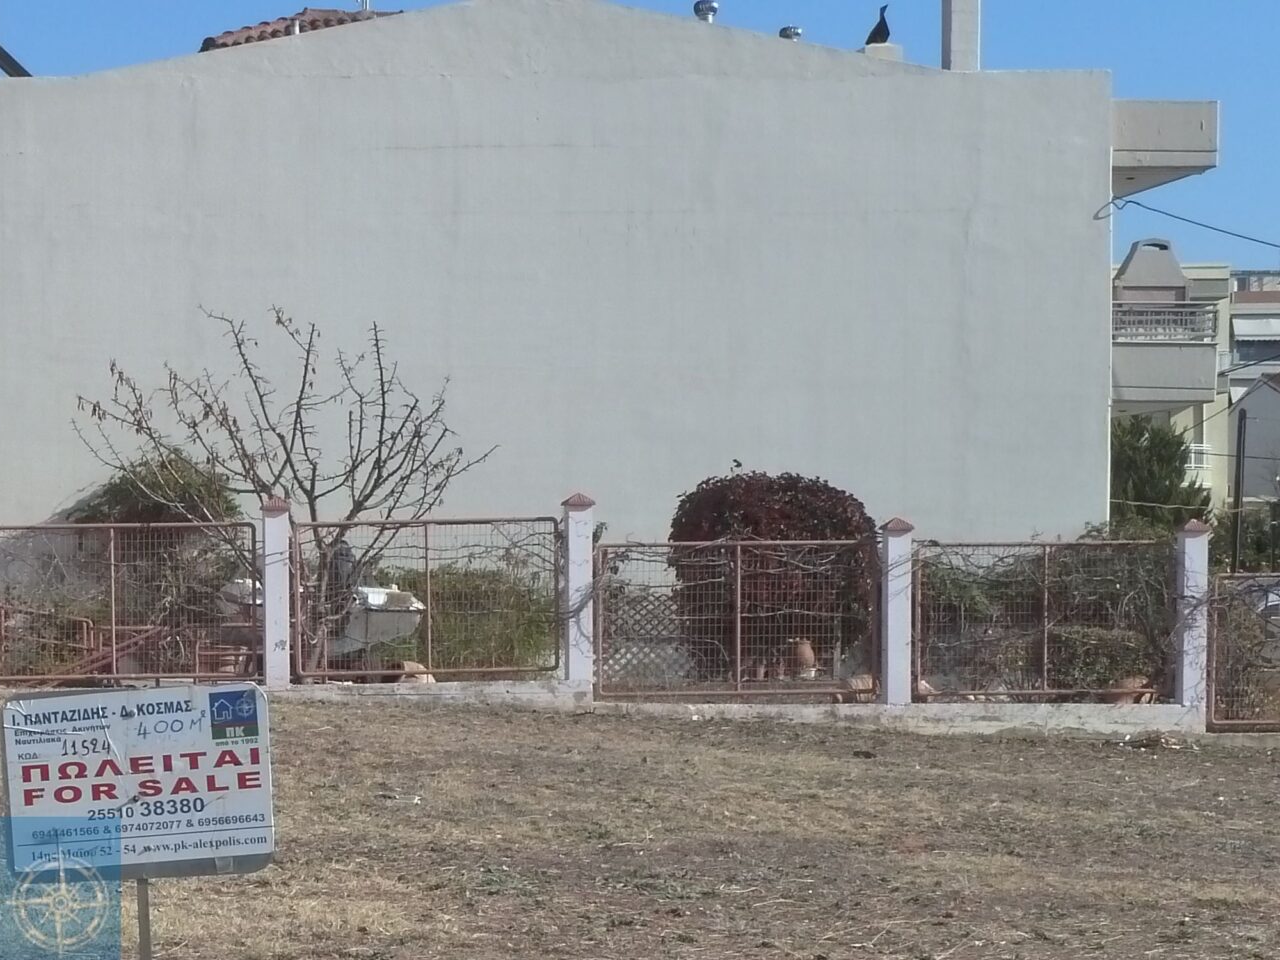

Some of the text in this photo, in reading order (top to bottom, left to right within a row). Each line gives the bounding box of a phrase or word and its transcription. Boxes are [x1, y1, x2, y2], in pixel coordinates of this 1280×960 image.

[24, 706, 108, 726] ΠΑΝΤΑΖΙΔΗΣ
[136, 700, 193, 717] ΚΟΣΜΑΣ
[136, 719, 184, 740] 400
[21, 747, 261, 784] ΠΩΛΕΙΤΑΙ
[23, 771, 262, 807] FOR SALE
[87, 797, 206, 821] 25510 38380
[103, 825, 112, 834] &
[114, 819, 182, 834] 6974072077
[185, 818, 194, 828] &
[197, 813, 266, 827] 6956696643
[99, 846, 113, 857] 52
[123, 844, 137, 855] 54
[142, 834, 268, 854] www.pk-alexpolis.com
